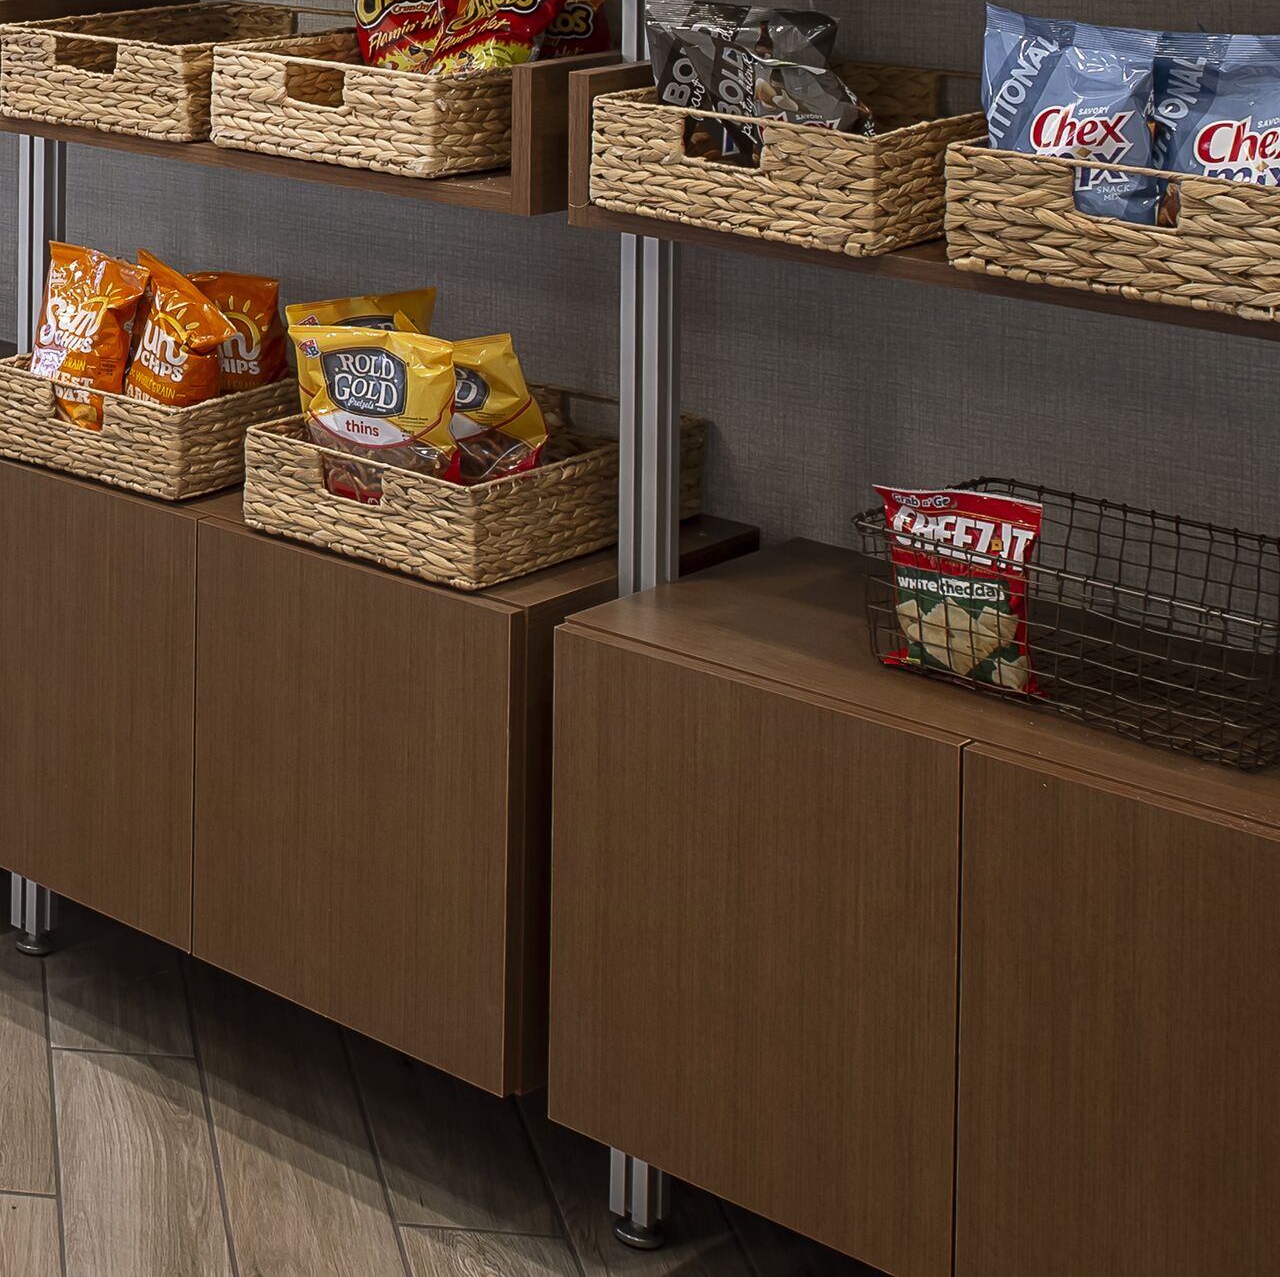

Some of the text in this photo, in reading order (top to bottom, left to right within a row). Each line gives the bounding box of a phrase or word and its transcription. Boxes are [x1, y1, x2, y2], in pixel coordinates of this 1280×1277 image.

[392, 2, 433, 14] Crunchy
[1078, 107, 1109, 115] SAVORY
[1032, 104, 1128, 148] Chex
[1097, 185, 1130, 195] SNACK
[1104, 194, 1121, 202] MIX
[54, 330, 93, 353] CHIPS
[337, 353, 395, 379] ROLD
[152, 384, 176, 399] GRAIN
[334, 373, 398, 408] GOLD
[348, 397, 375, 409] Pretzels
[345, 419, 379, 437] thins
[892, 493, 920, 507] Grab
